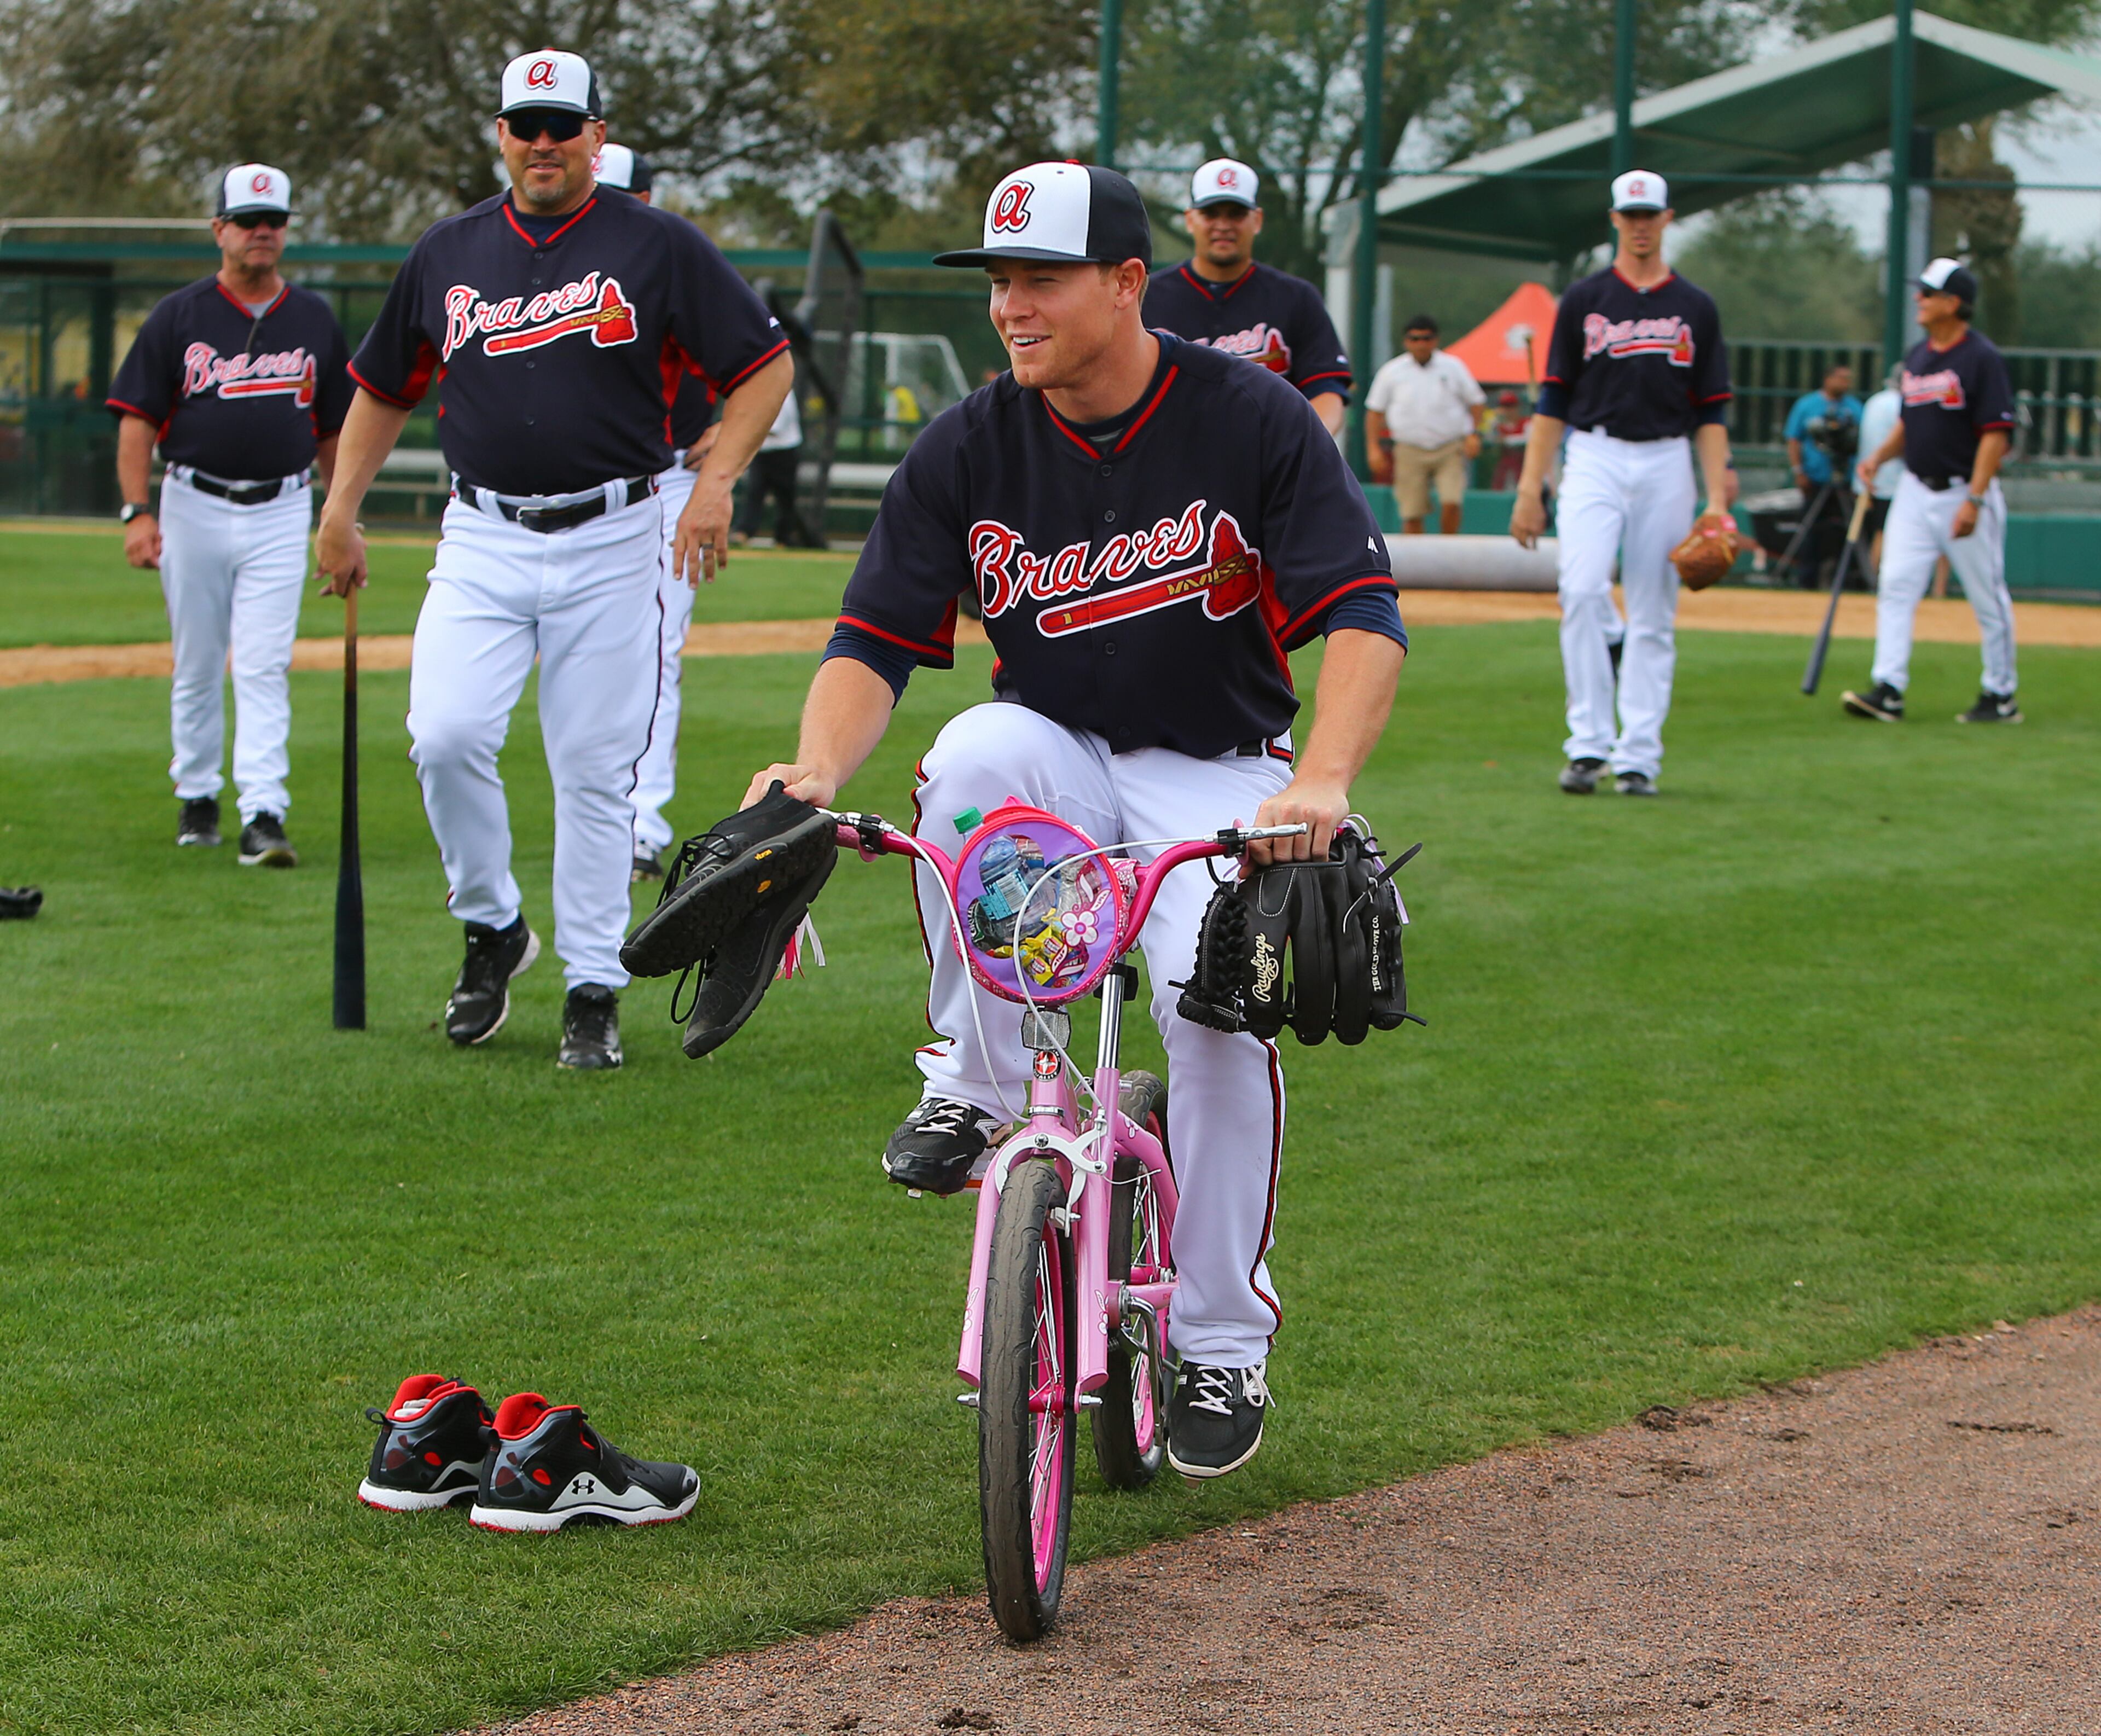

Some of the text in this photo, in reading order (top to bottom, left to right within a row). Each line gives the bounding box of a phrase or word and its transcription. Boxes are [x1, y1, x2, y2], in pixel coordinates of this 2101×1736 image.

[524, 59, 558, 89] a
[991, 181, 1034, 234] a
[442, 271, 600, 362] Braves
[183, 342, 305, 398] Braves
[969, 499, 1206, 618] Braves
[1250, 932, 1279, 1002] Rawlings
[1372, 976, 1382, 991] THE
